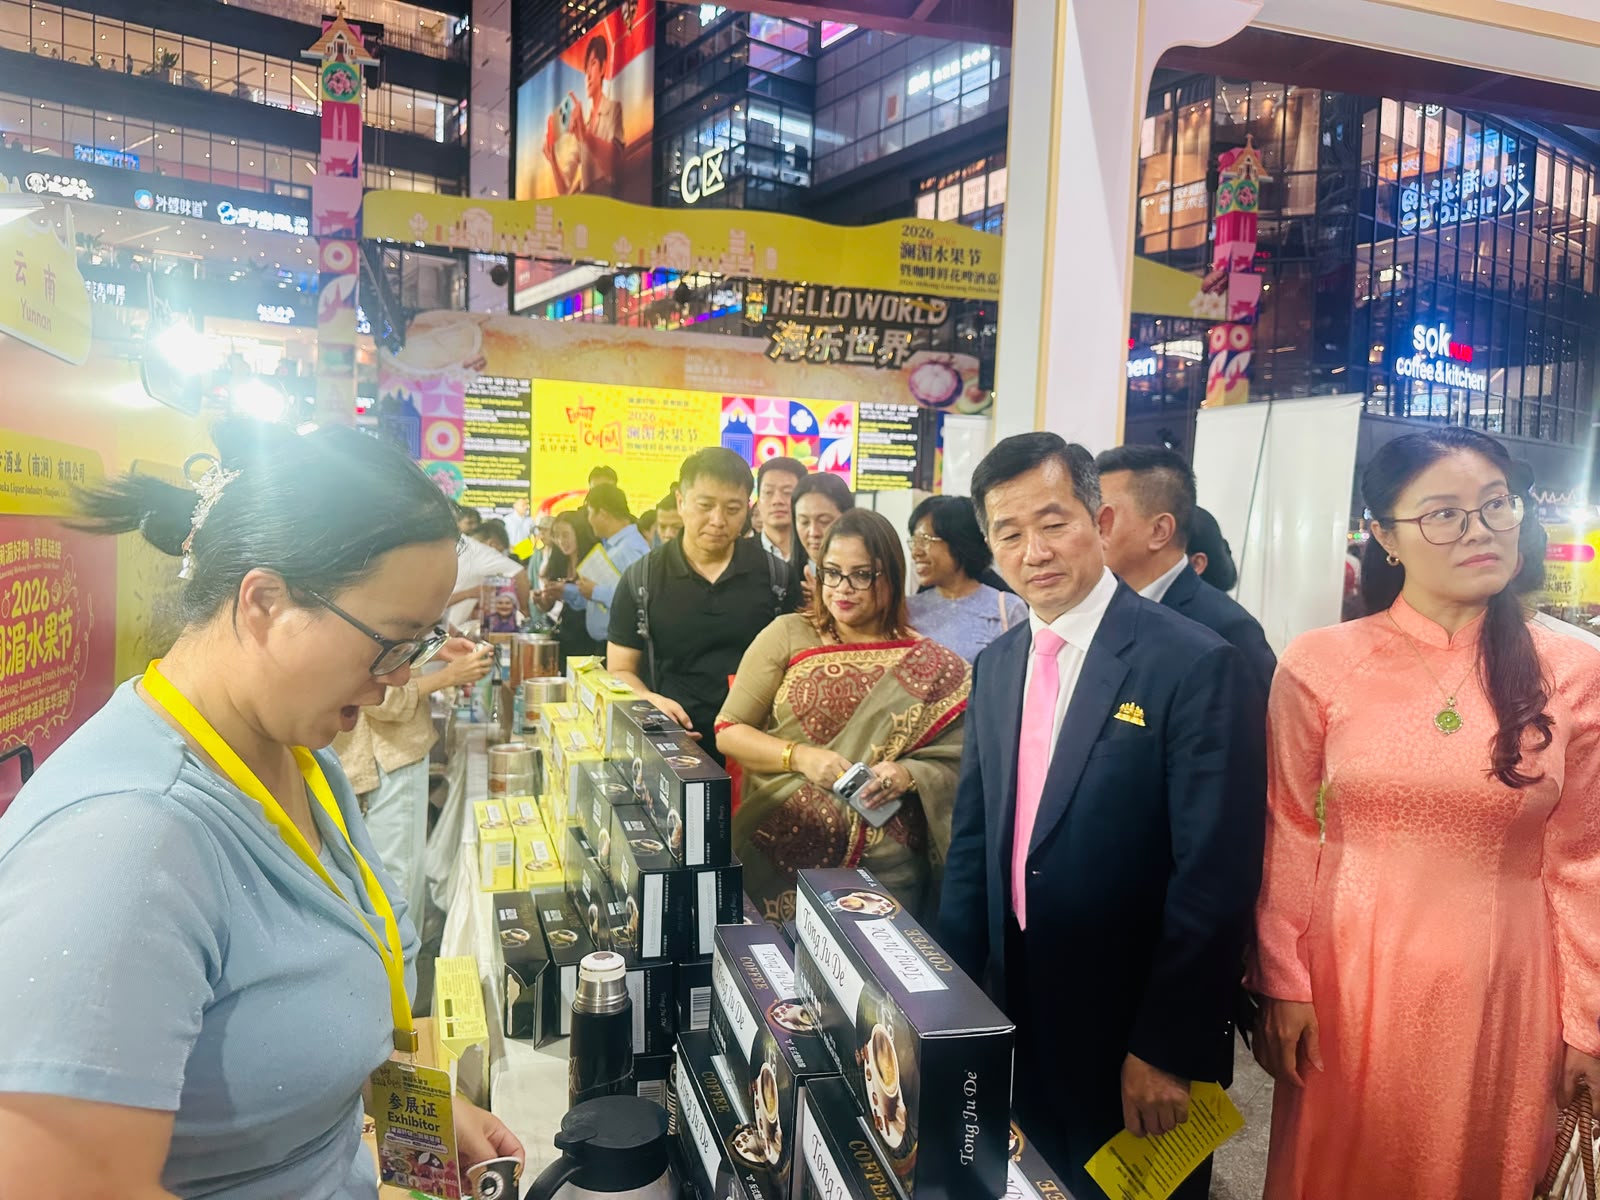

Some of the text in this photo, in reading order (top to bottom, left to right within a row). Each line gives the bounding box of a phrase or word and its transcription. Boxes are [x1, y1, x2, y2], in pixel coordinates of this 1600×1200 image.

[902, 224, 934, 238] 2026
[900, 241, 982, 266] 澜湄水果节
[20, 297, 52, 333] Yunnan
[771, 286, 850, 319] HELLO
[854, 292, 949, 326] WORLD
[1396, 355, 1487, 392] coffee & kitchen
[11, 577, 50, 618] 2026
[0, 606, 74, 681] 湄水果节
[804, 908, 845, 987] Tong Ju De
[903, 928, 953, 972] COFFEE
[740, 956, 769, 990] COFFEE
[388, 1092, 438, 1118] 参展证
[701, 1071, 731, 1113] COFFEE
[387, 1111, 441, 1133] Exhibitor
[960, 1071, 980, 1166] Tong Ju De
[848, 1140, 897, 1200] COFFE
